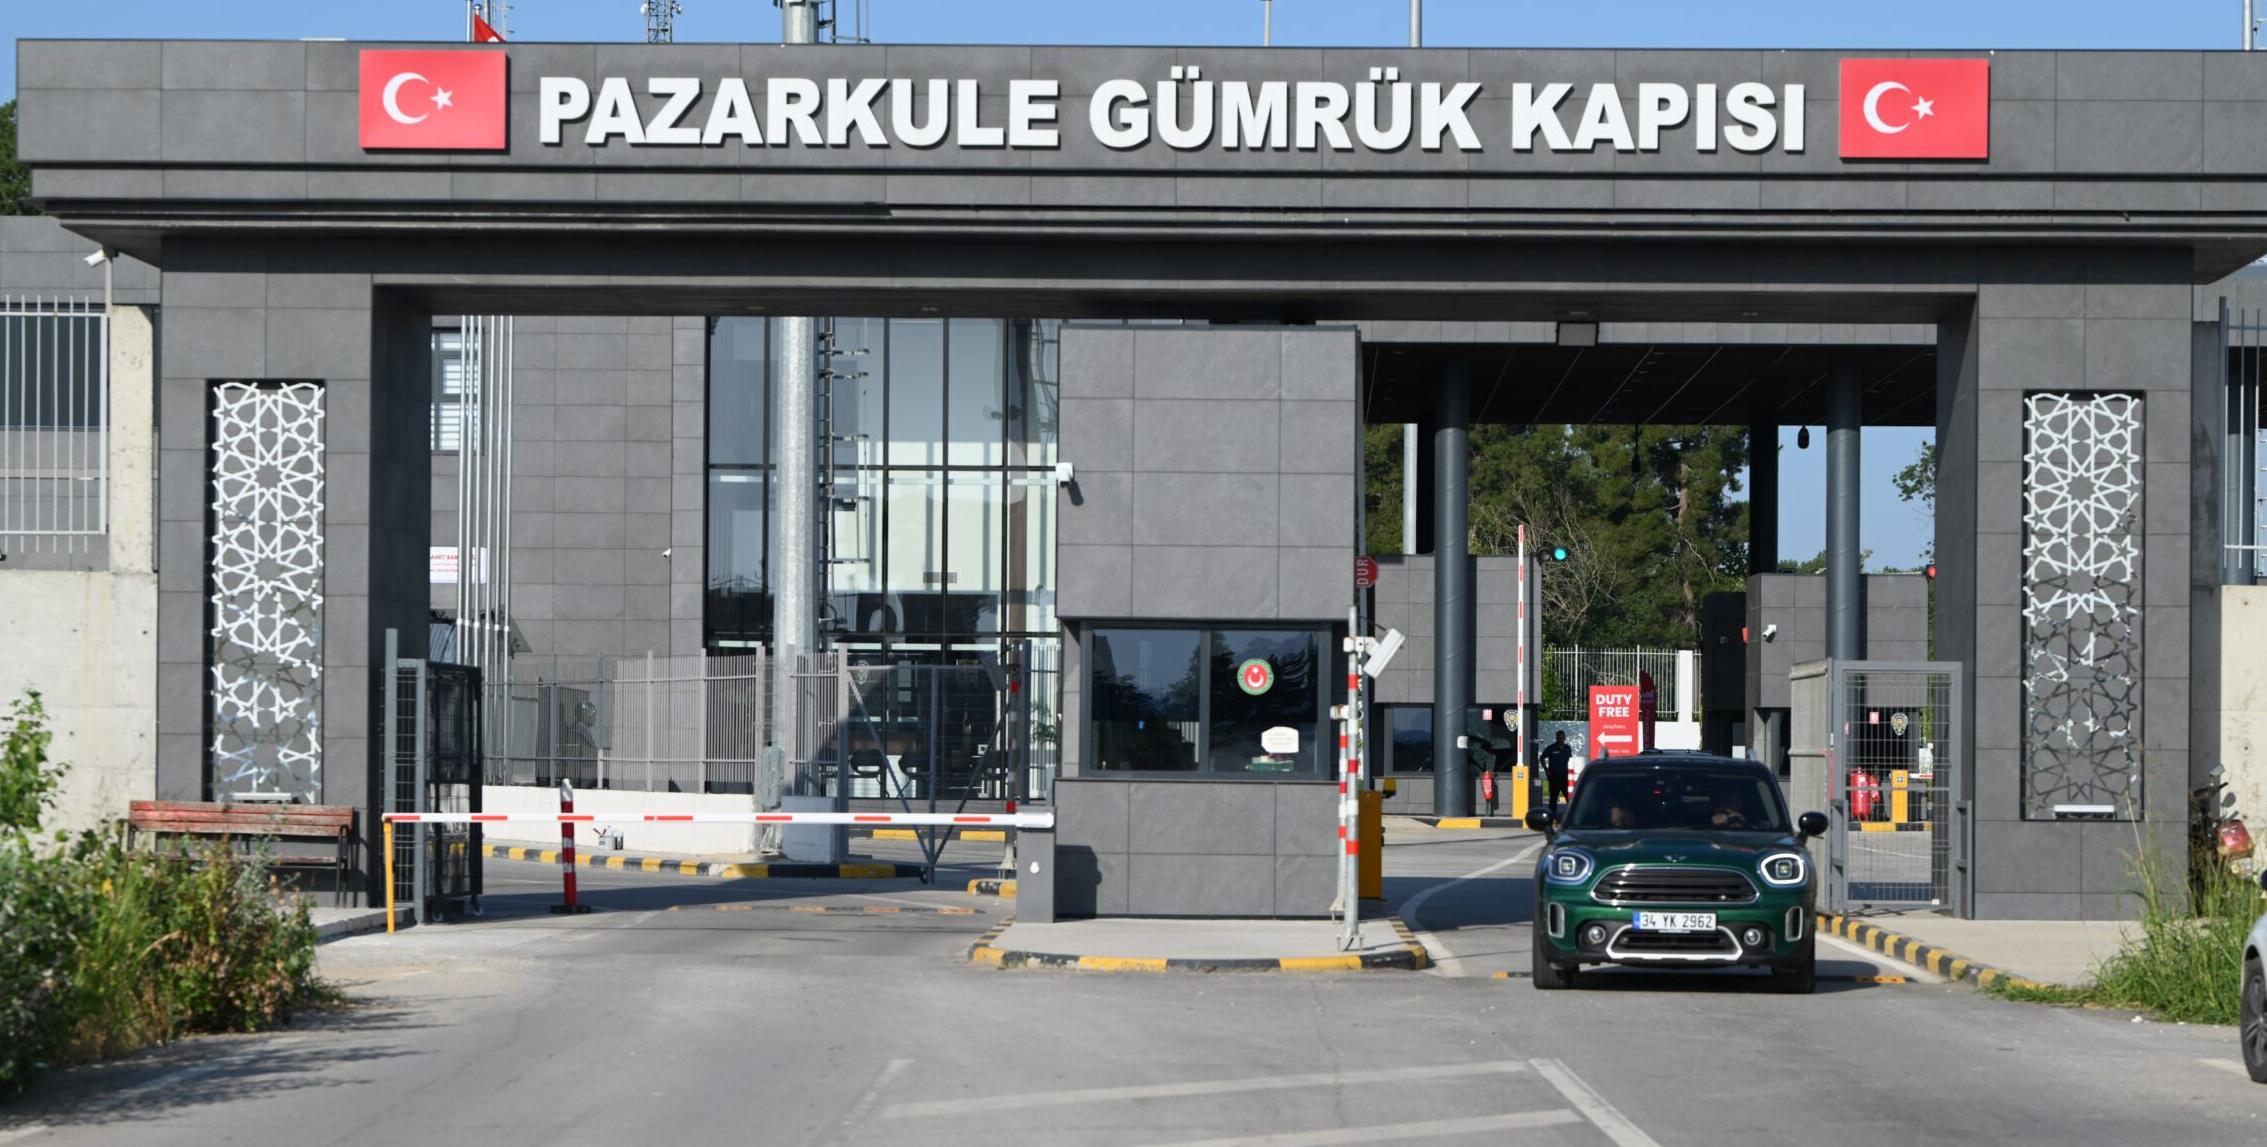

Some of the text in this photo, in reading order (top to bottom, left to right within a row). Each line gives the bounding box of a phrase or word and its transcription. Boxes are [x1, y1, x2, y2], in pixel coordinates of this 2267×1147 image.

[539, 65, 1805, 151] PAZARKULE GÜMRÜK KAPISI
[1357, 558, 1369, 585] DUR
[1595, 694, 1632, 705] DUTY
[1598, 706, 1630, 718] FREE
[1642, 914, 1656, 927] 34
[1662, 914, 1677, 928] YK
[1682, 915, 1712, 929] 2962
